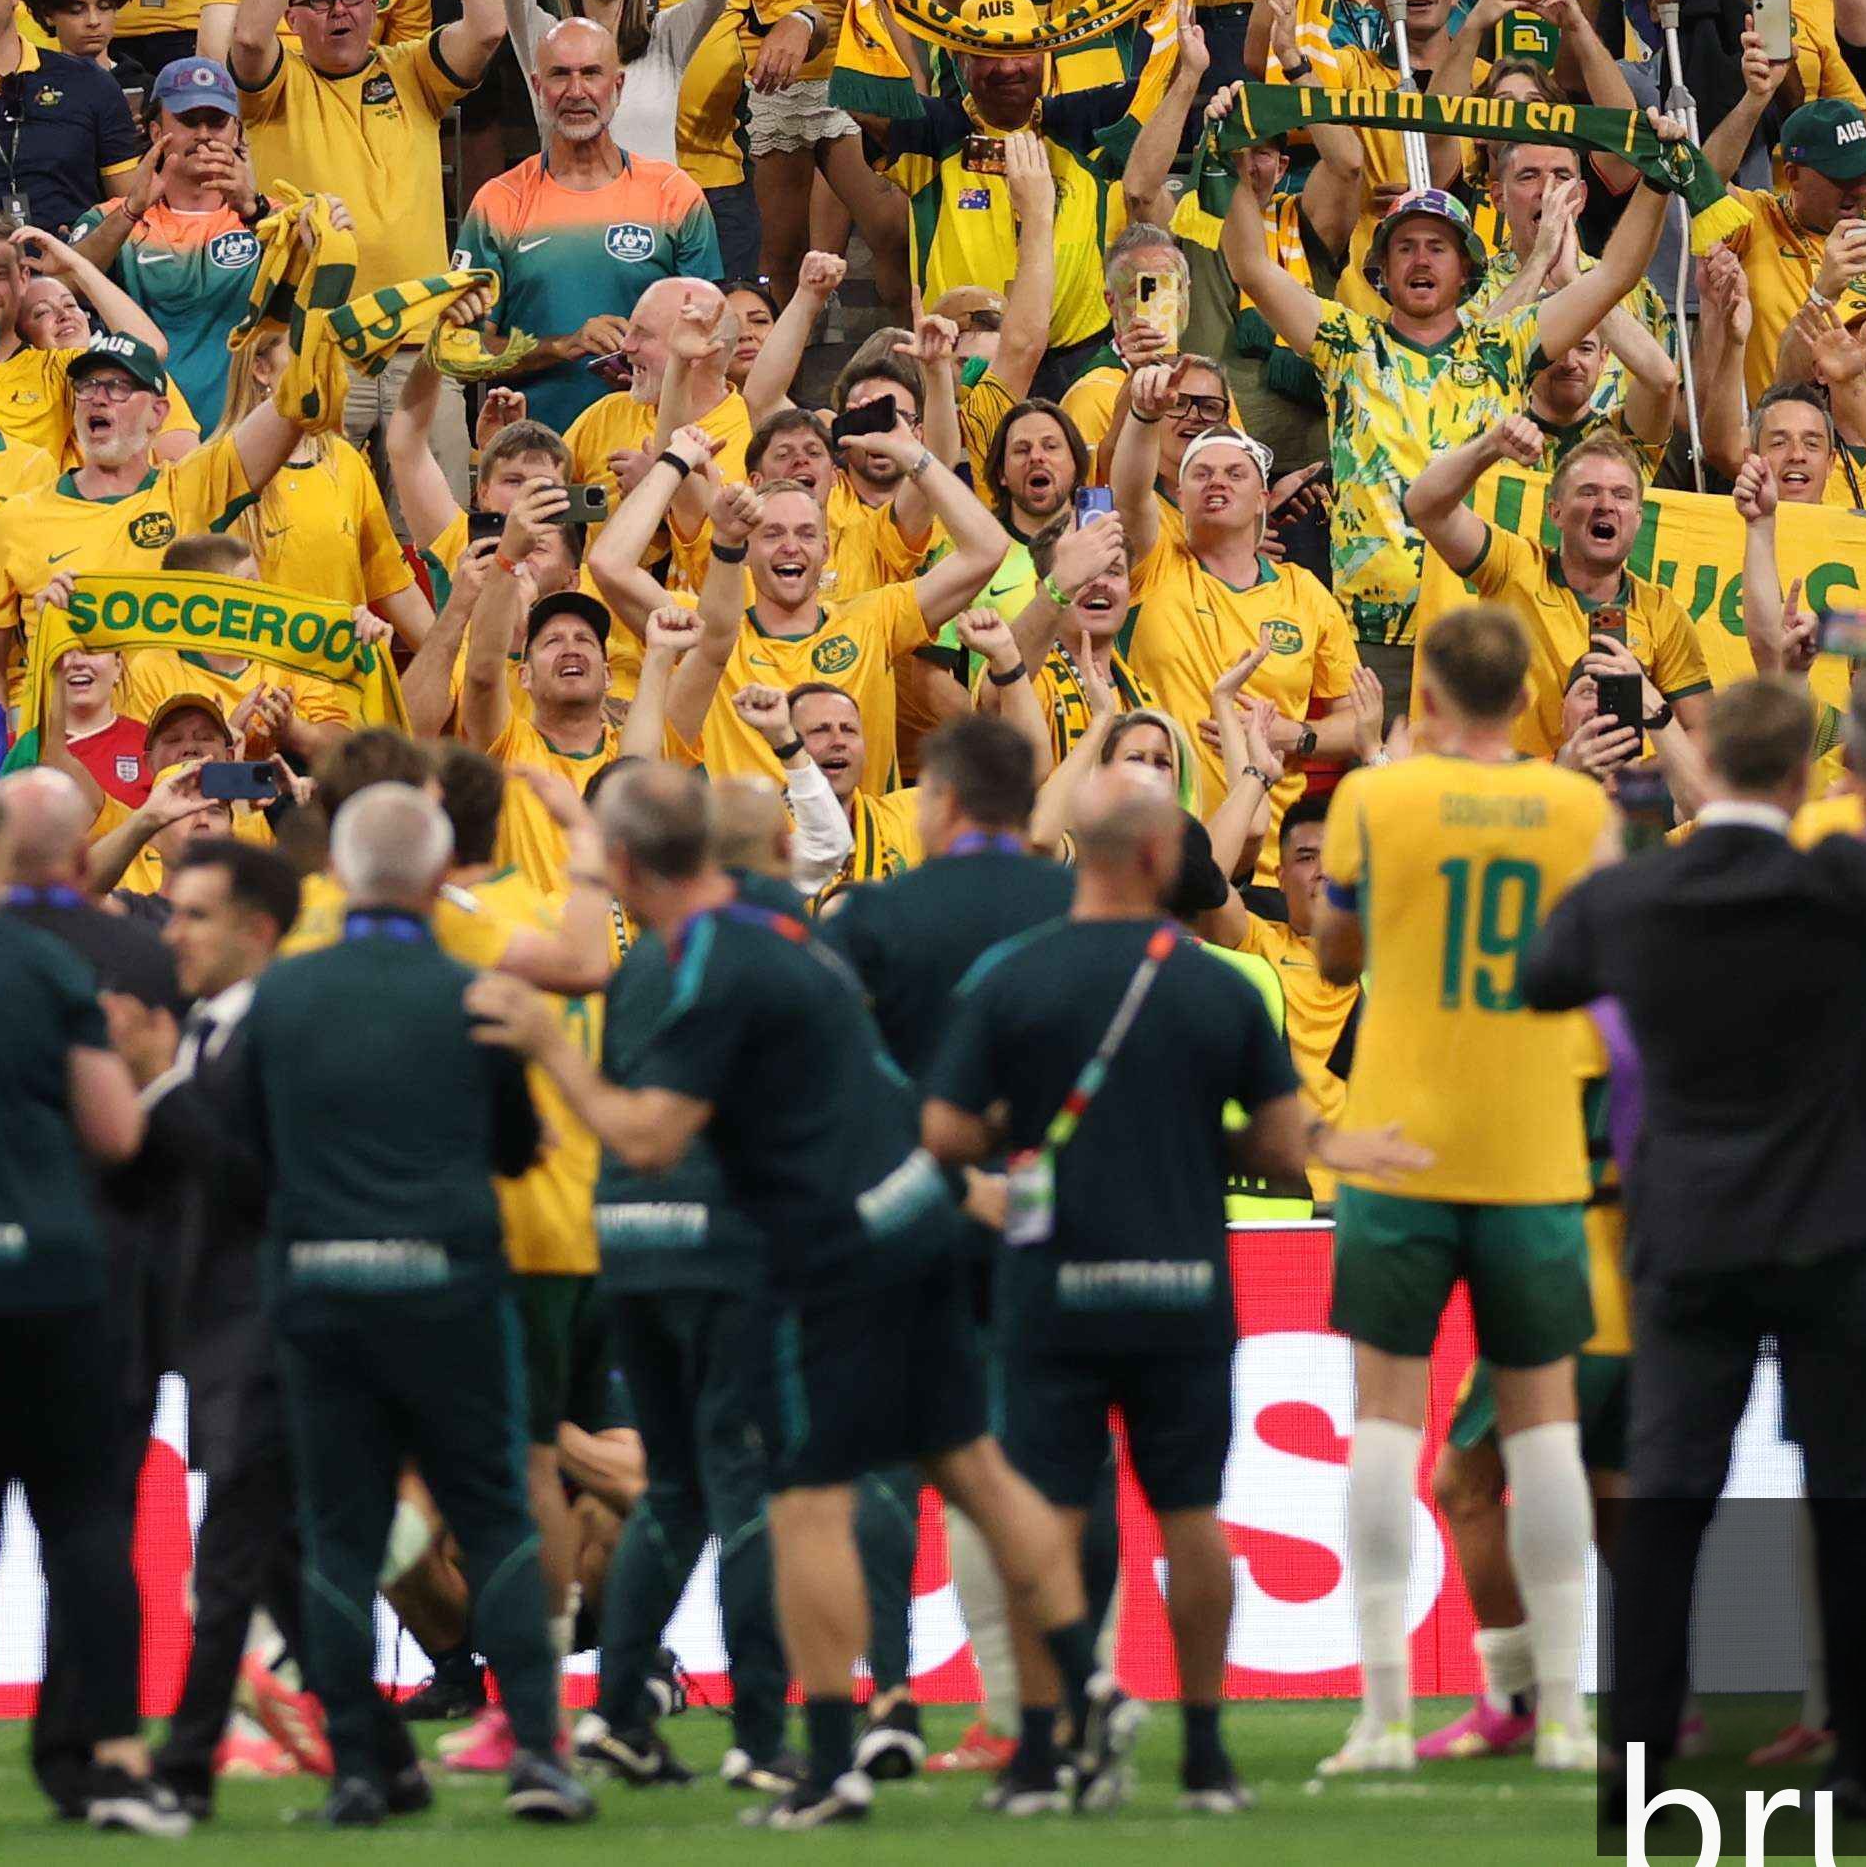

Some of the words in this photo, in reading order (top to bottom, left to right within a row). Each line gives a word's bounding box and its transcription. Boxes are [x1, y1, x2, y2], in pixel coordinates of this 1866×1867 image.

[977, 0, 1016, 21] AUS
[1084, 12, 1121, 34] CUP
[68, 590, 376, 672] SOCCEROOS
[1436, 856, 1542, 1013] 19
